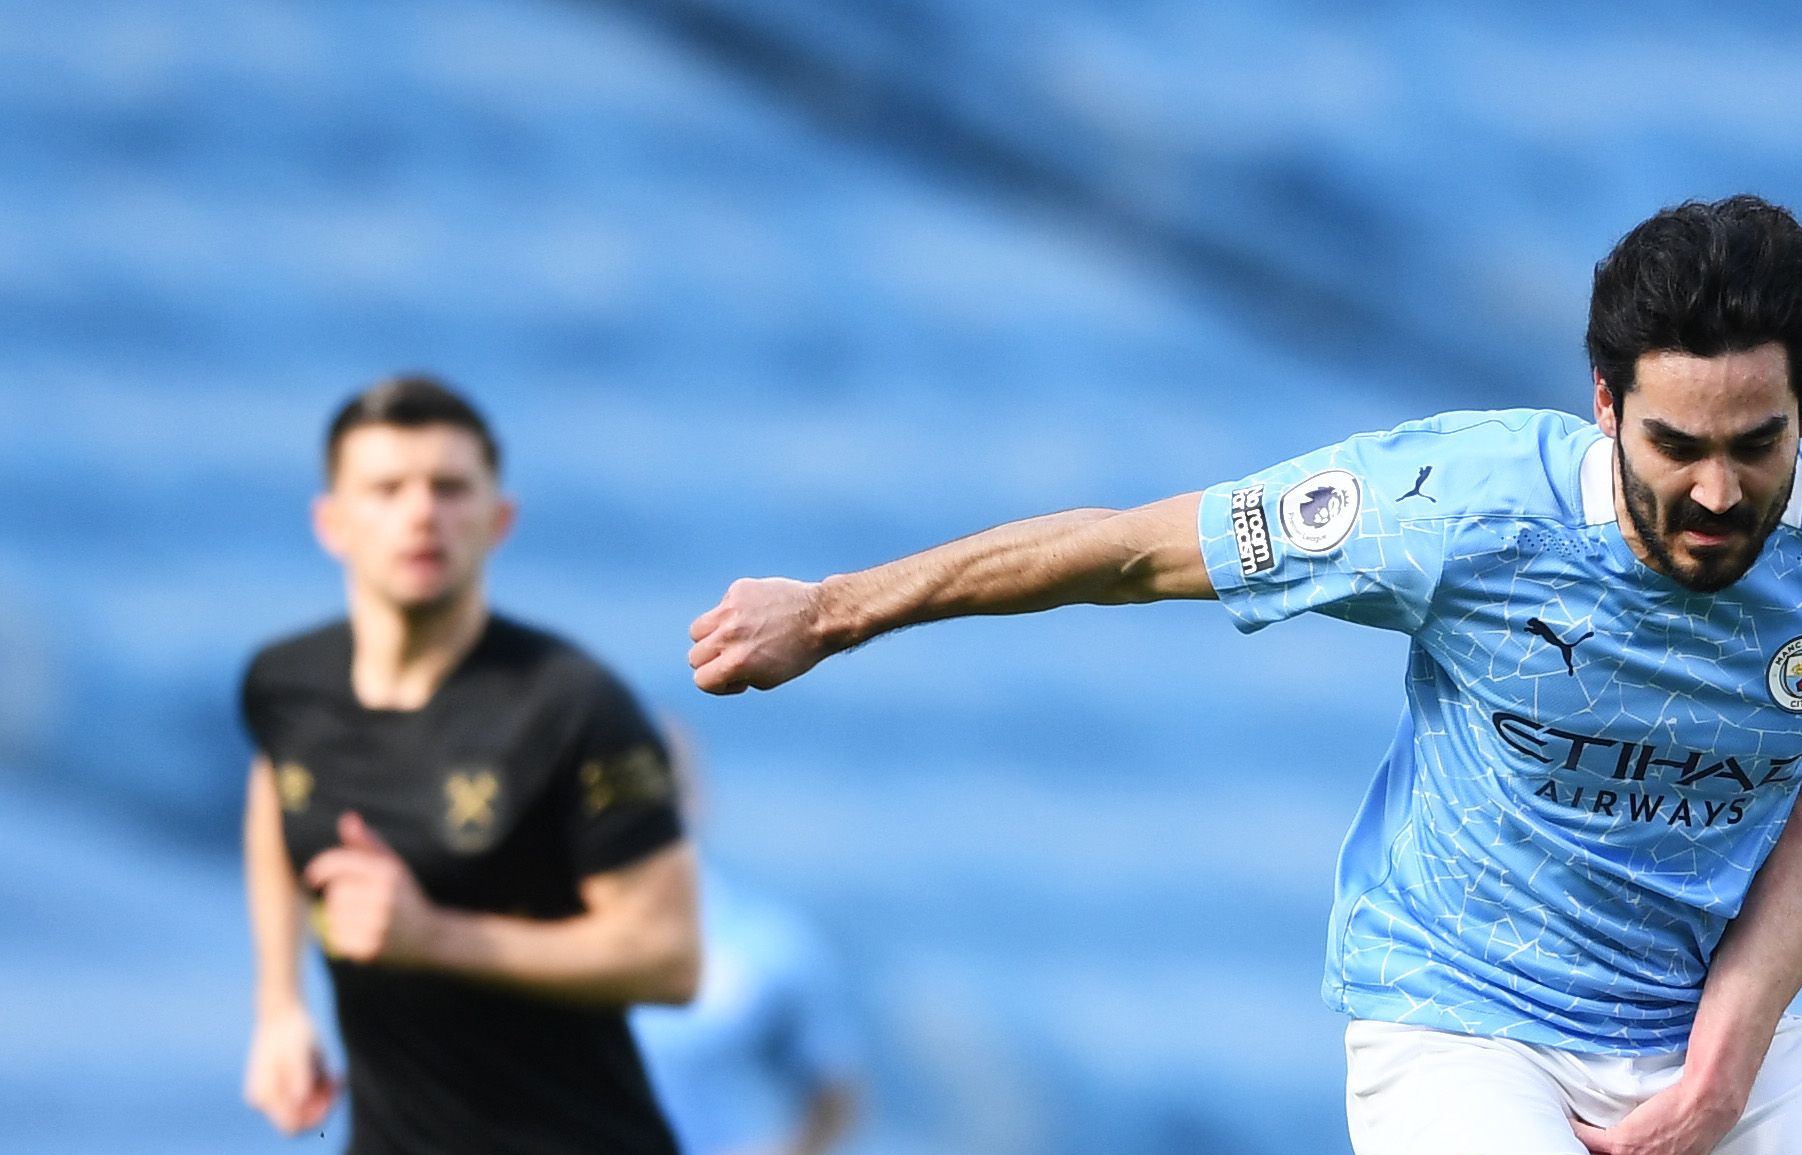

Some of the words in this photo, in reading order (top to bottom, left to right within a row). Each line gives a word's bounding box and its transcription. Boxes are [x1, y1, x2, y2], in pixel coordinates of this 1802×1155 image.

[1232, 510, 1257, 575] racism
[1246, 508, 1270, 563] room
[1533, 778, 1746, 828] AIRWAYS
